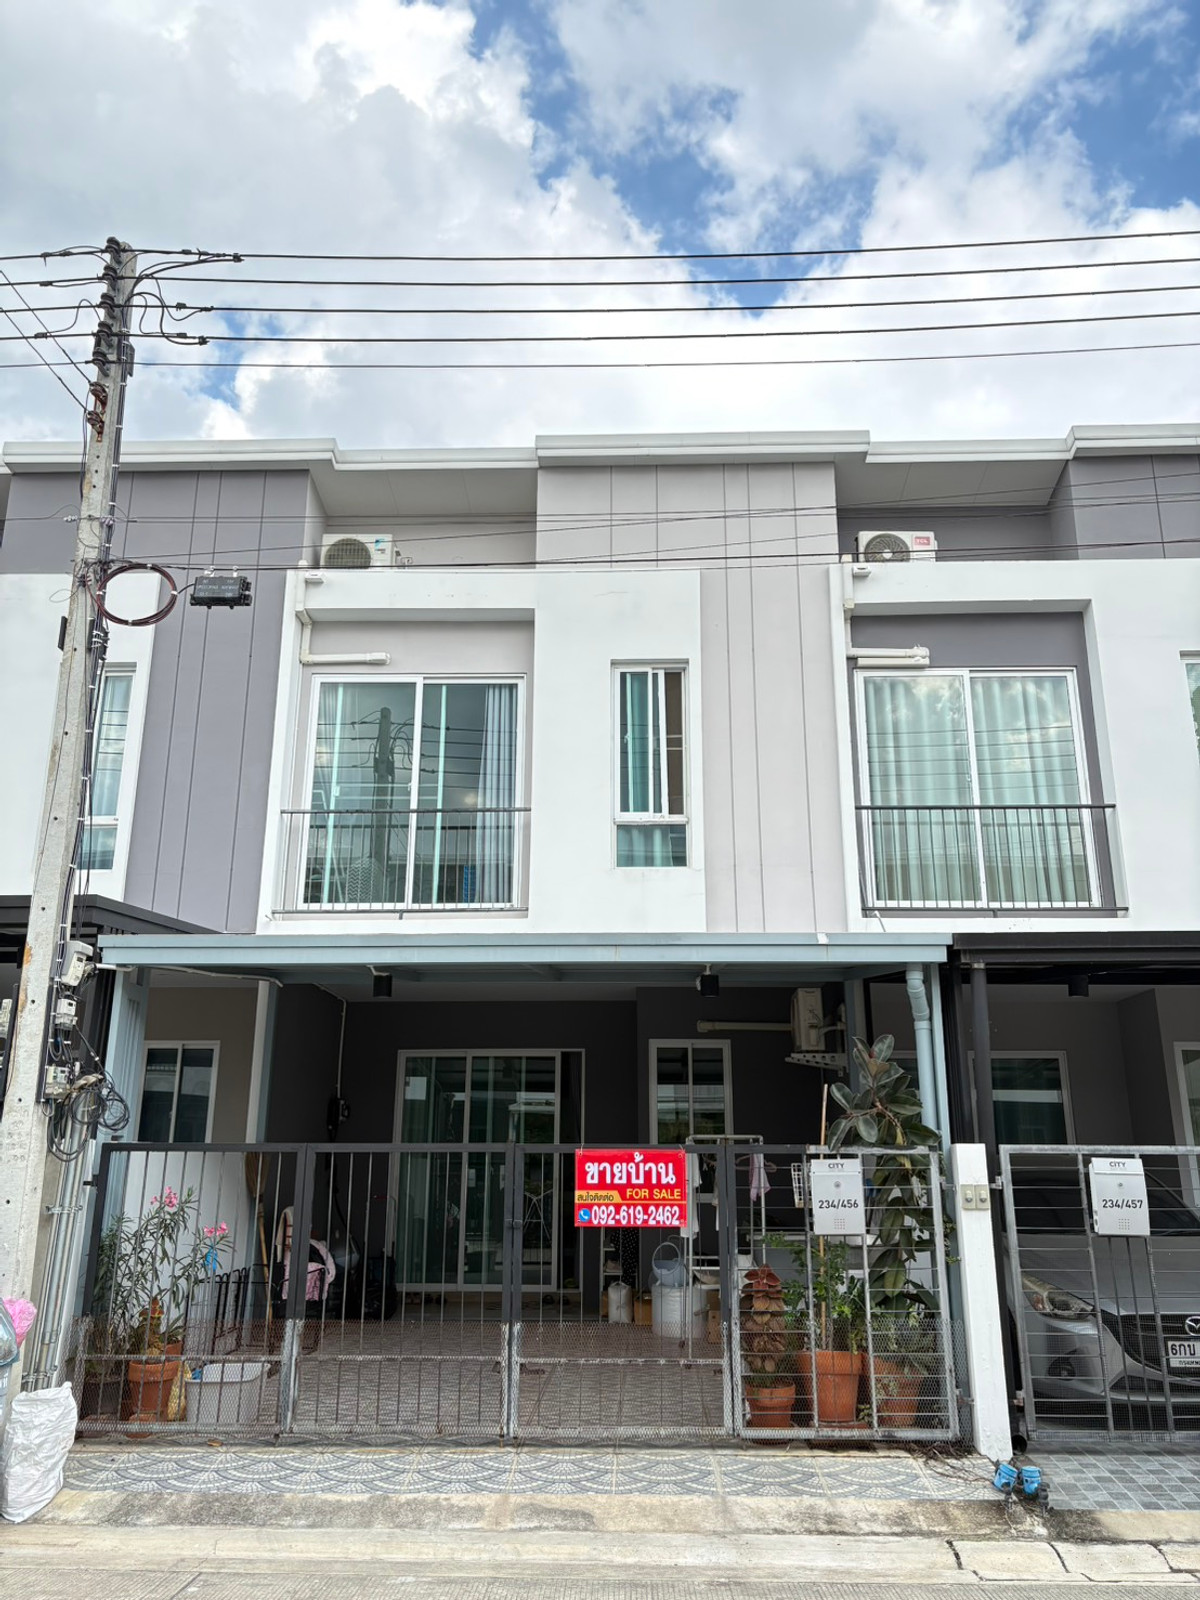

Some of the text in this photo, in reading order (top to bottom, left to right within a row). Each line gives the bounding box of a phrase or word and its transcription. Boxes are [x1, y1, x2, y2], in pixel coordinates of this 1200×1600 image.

[585, 1152, 676, 1184] ขายบ้าน
[626, 1188, 681, 1199] FOR SALE
[818, 1199, 859, 1209] 234/456
[1102, 1199, 1143, 1209] 234/457
[591, 1205, 680, 1225] 092-619-2462
